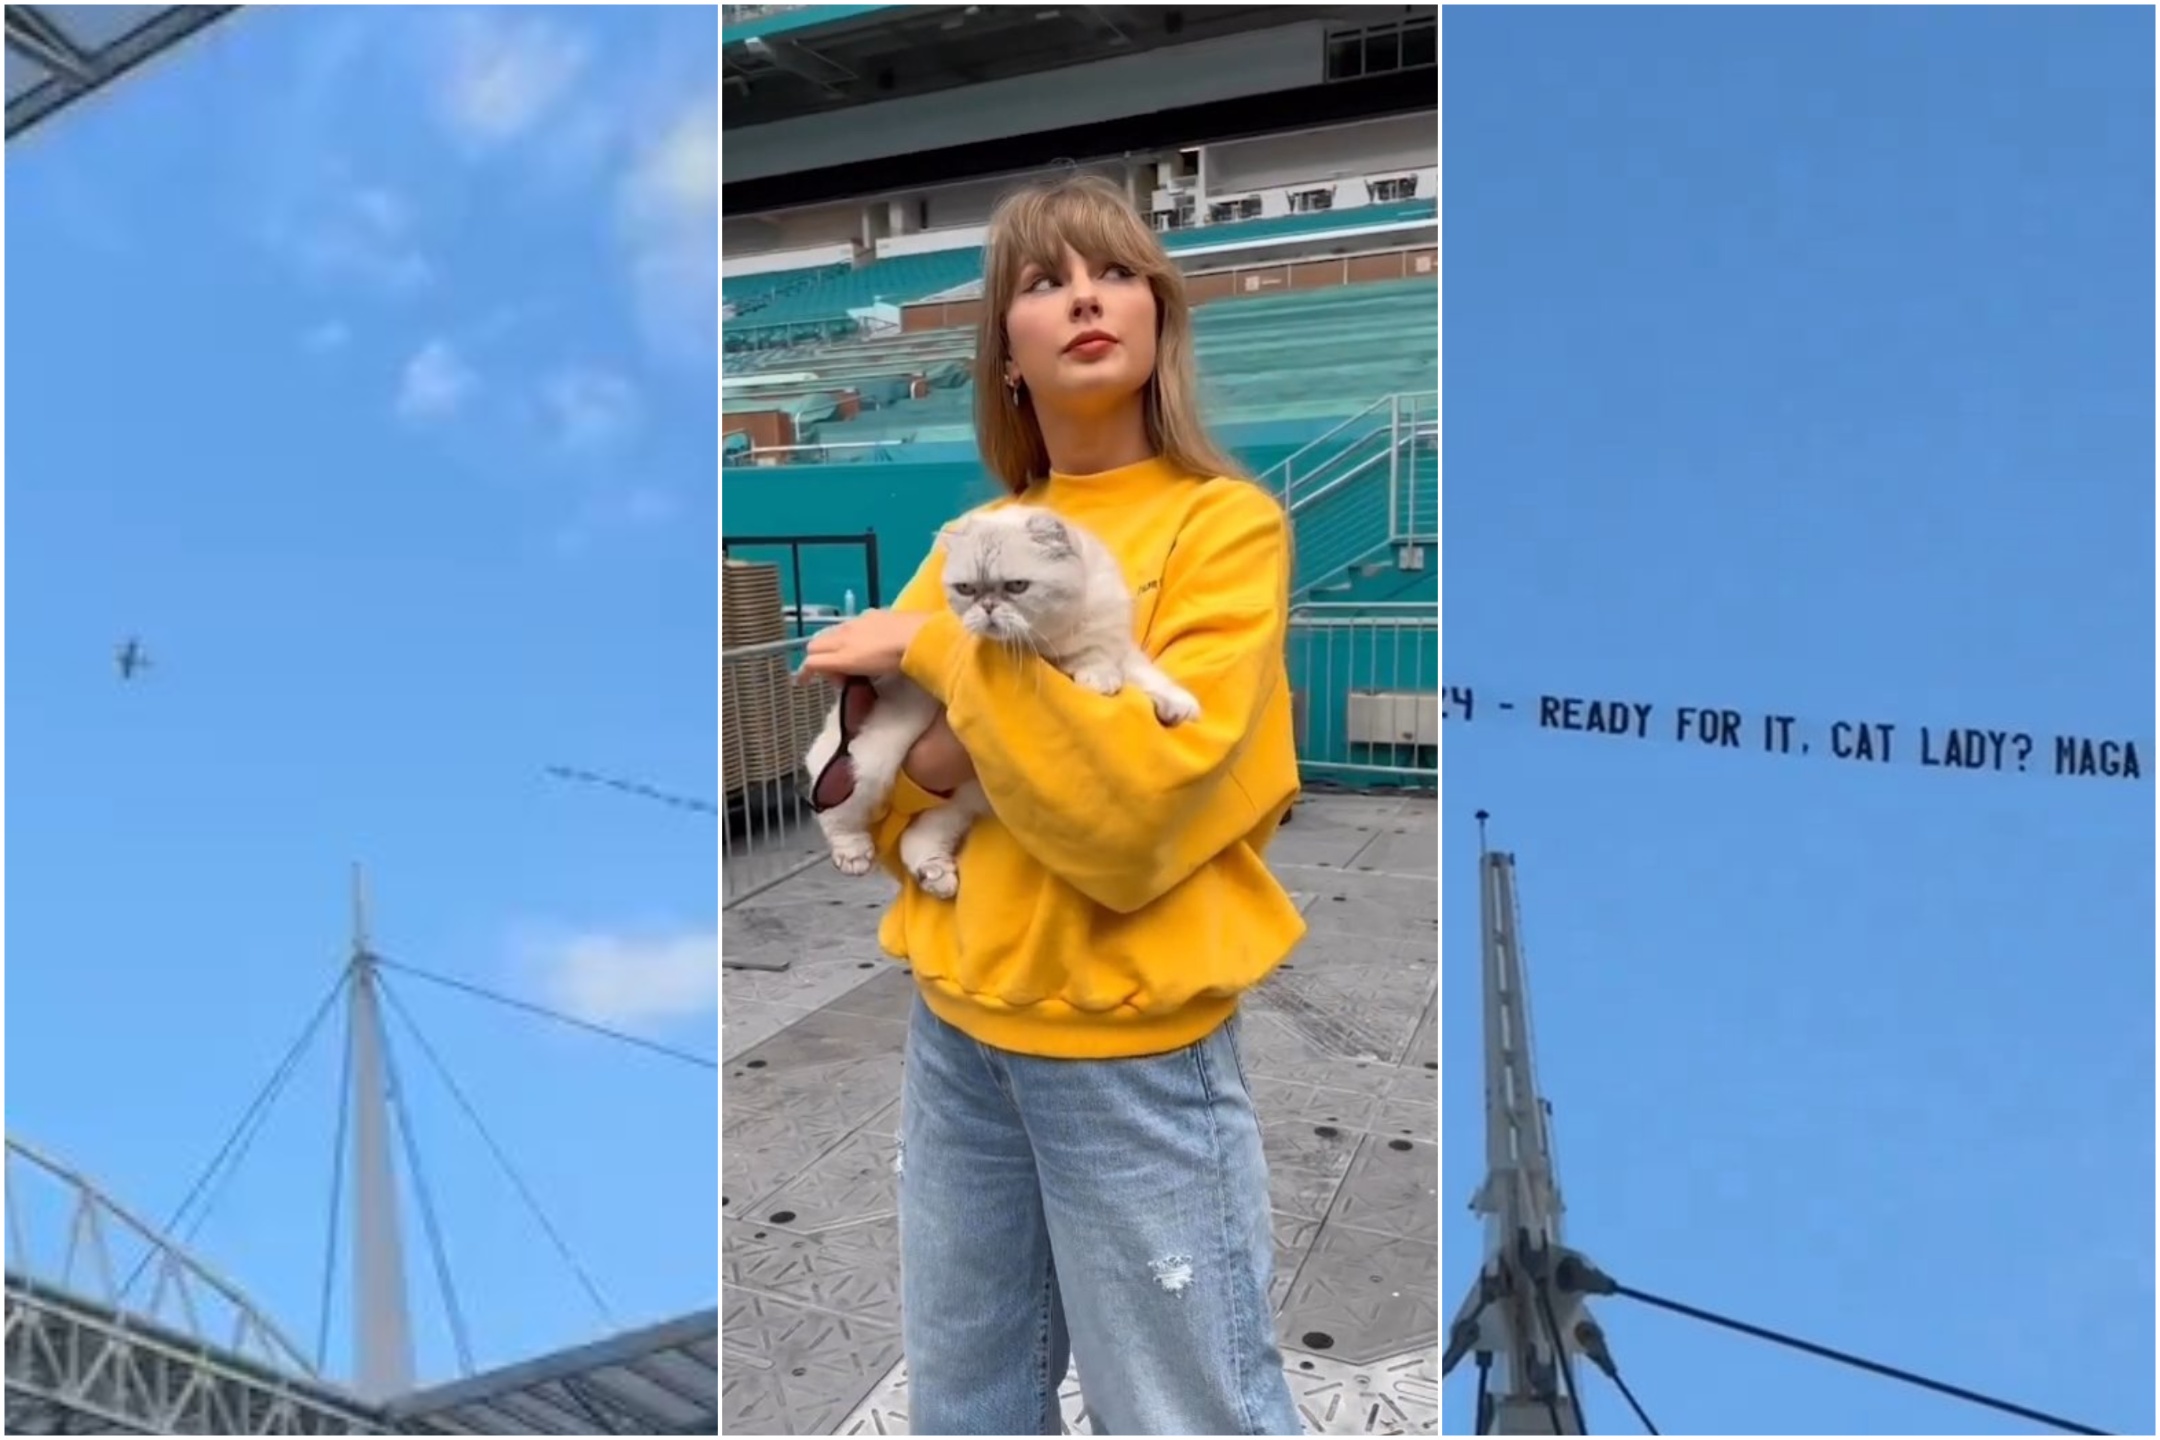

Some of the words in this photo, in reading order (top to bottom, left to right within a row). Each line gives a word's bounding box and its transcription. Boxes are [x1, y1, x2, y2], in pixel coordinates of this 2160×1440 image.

[1499, 702, 1514, 710] -
[1540, 695, 1653, 738] READY
[1676, 706, 1742, 748] FOR
[1831, 720, 1896, 763] CAT
[1920, 726, 2033, 772] LADY?
[2054, 735, 2141, 779] MAGA
